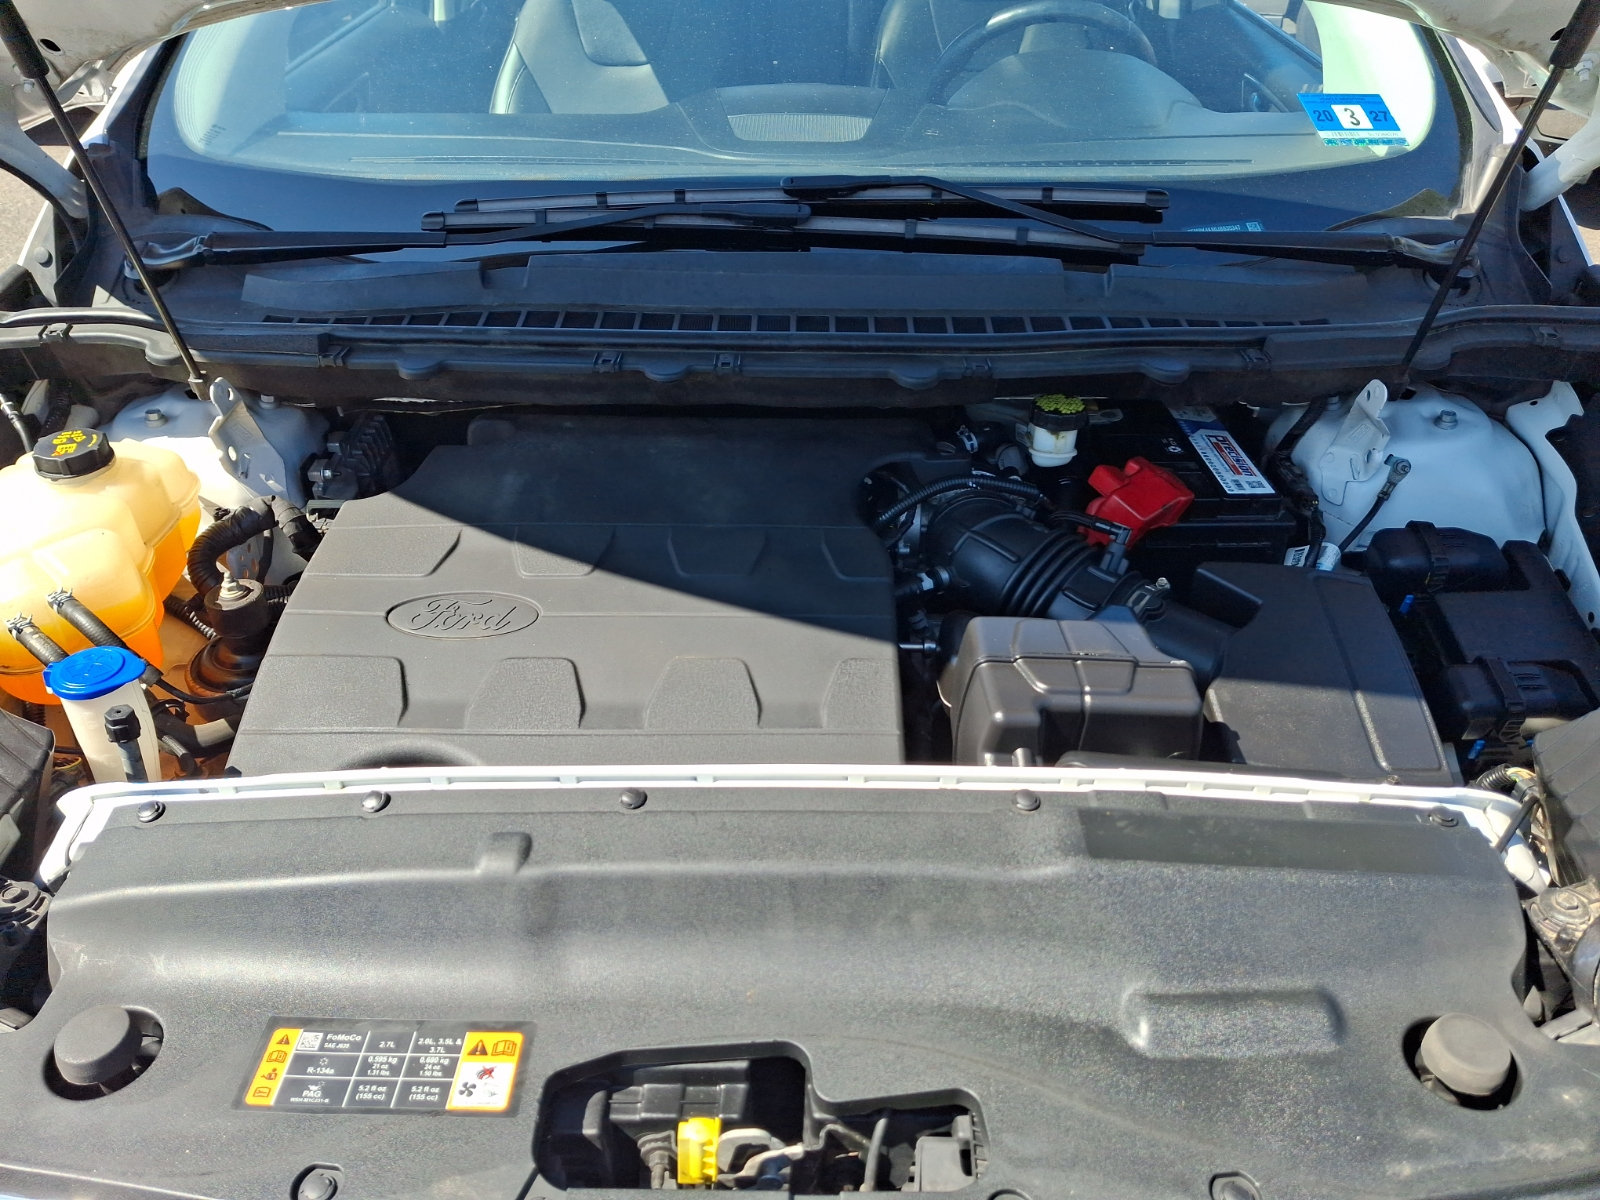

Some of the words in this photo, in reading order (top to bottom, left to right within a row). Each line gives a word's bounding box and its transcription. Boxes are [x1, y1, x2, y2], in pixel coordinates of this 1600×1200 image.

[1313, 109, 1334, 122] 20
[1343, 107, 1361, 126] 3
[1369, 110, 1388, 122] 27
[410, 599, 518, 631] Ford
[326, 1033, 362, 1041] FoMoCo
[387, 1055, 398, 1064] kg
[440, 1056, 450, 1065] kg
[306, 1066, 335, 1074] R-134a
[358, 1084, 370, 1092] 5.2
[411, 1085, 423, 1093] 5.2
[302, 1090, 322, 1098] PAG
[355, 1093, 373, 1101] (155
[373, 1093, 385, 1101] cc)
[408, 1094, 426, 1102] (155
[426, 1094, 439, 1102] cc)
